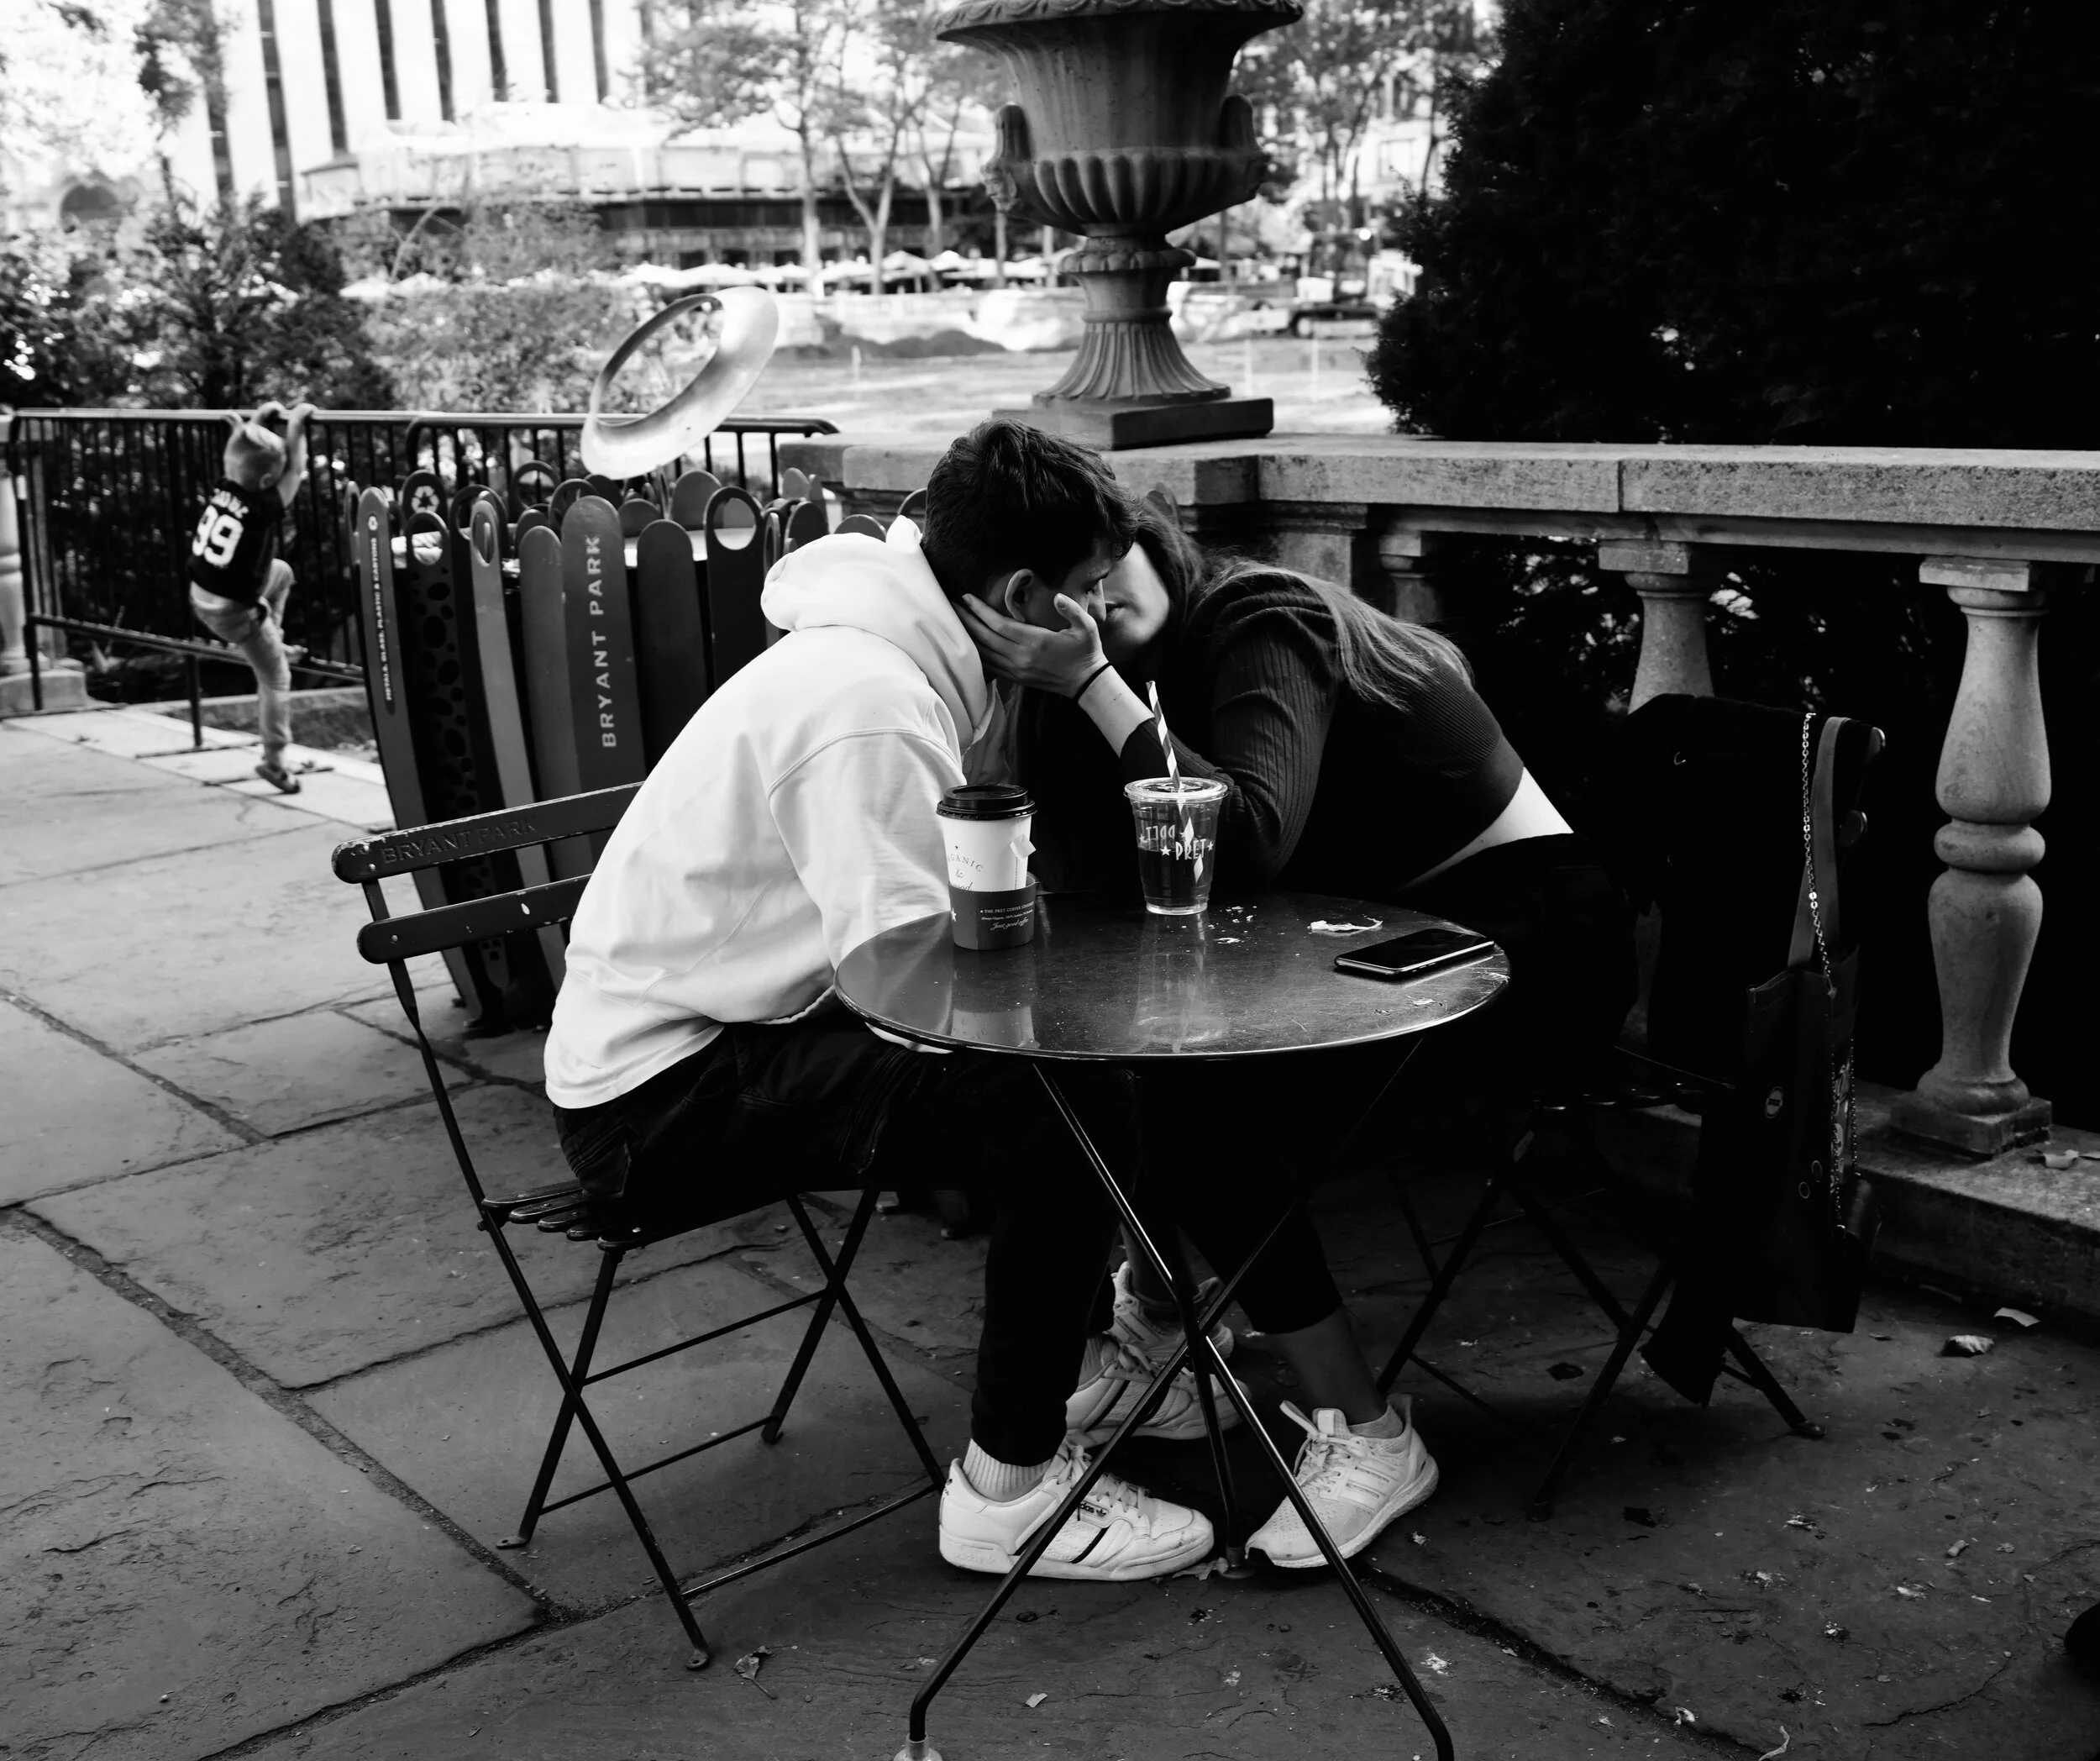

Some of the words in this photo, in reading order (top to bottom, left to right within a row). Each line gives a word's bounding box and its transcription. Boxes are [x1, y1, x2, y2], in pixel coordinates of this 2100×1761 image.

[192, 505, 244, 569] 99
[585, 534, 604, 615] PARK
[591, 630, 617, 748] BRYANT
[381, 830, 471, 865] BRYANT
[475, 816, 538, 844] PARK
[1175, 838, 1207, 860] PRET
